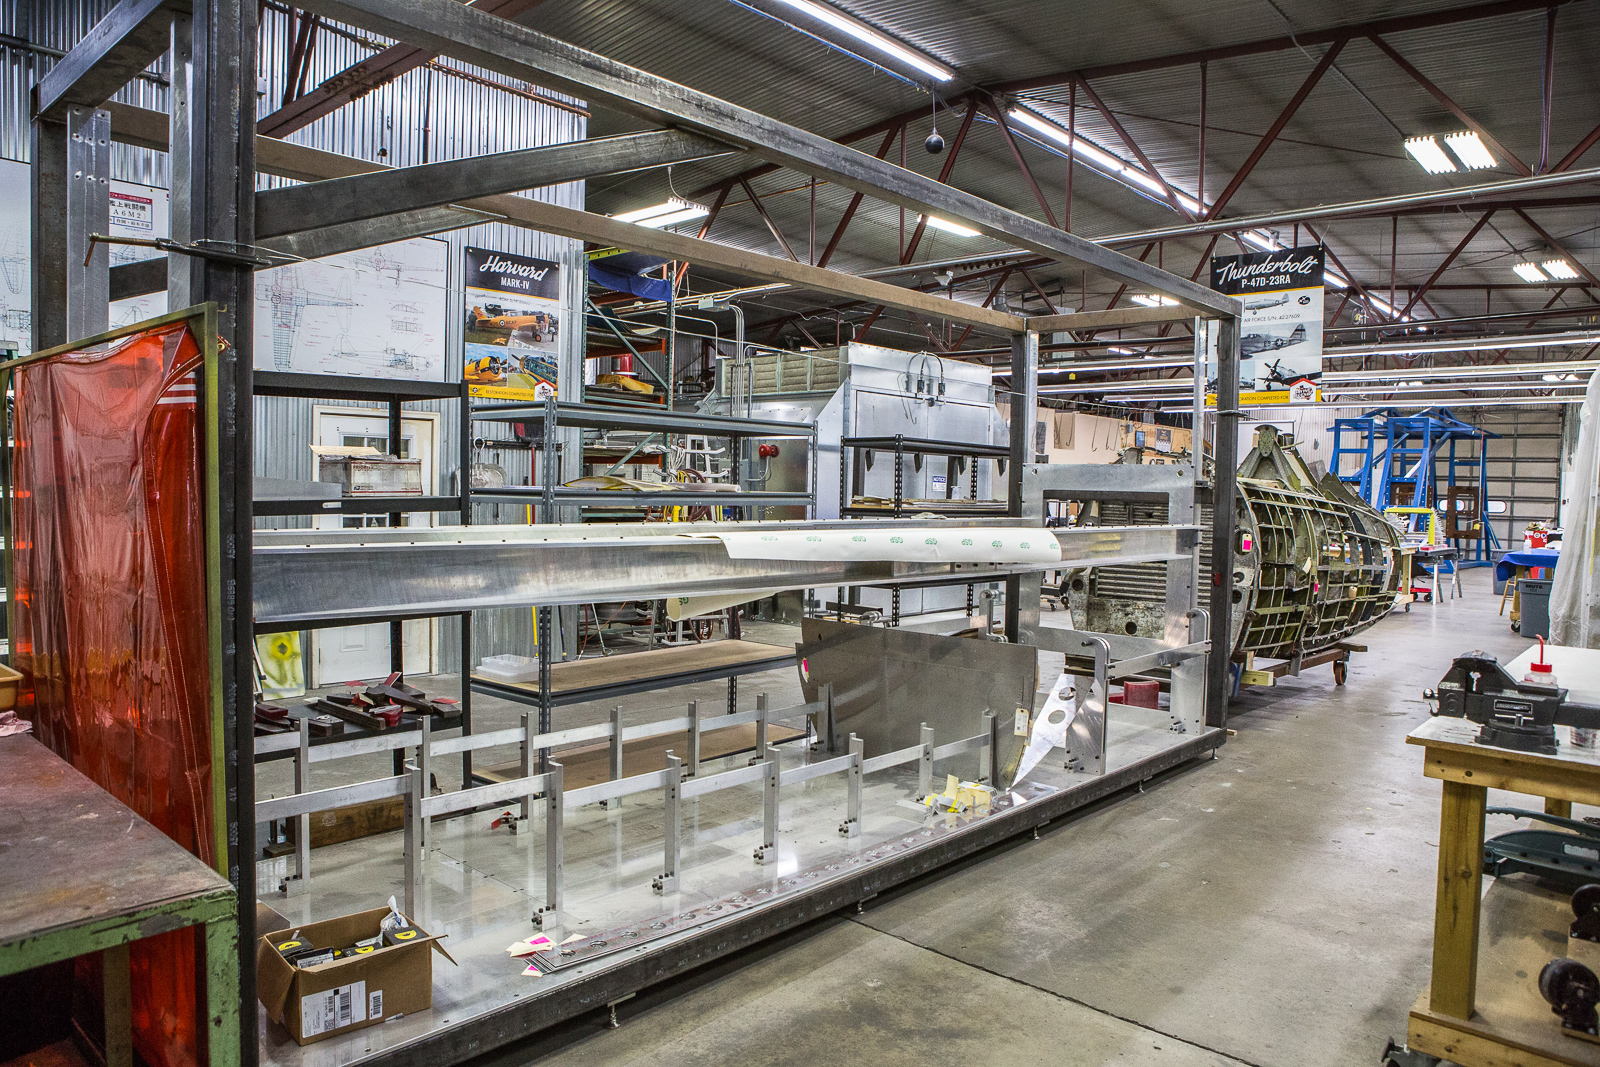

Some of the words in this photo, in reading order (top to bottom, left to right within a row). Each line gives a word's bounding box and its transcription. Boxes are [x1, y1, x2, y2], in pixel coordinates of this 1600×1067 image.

[479, 255, 550, 282] Harvard
[1216, 253, 1319, 286] Thunderbolt
[500, 276, 530, 290] MARK-IV
[1241, 274, 1291, 288] P-47D-23RA
